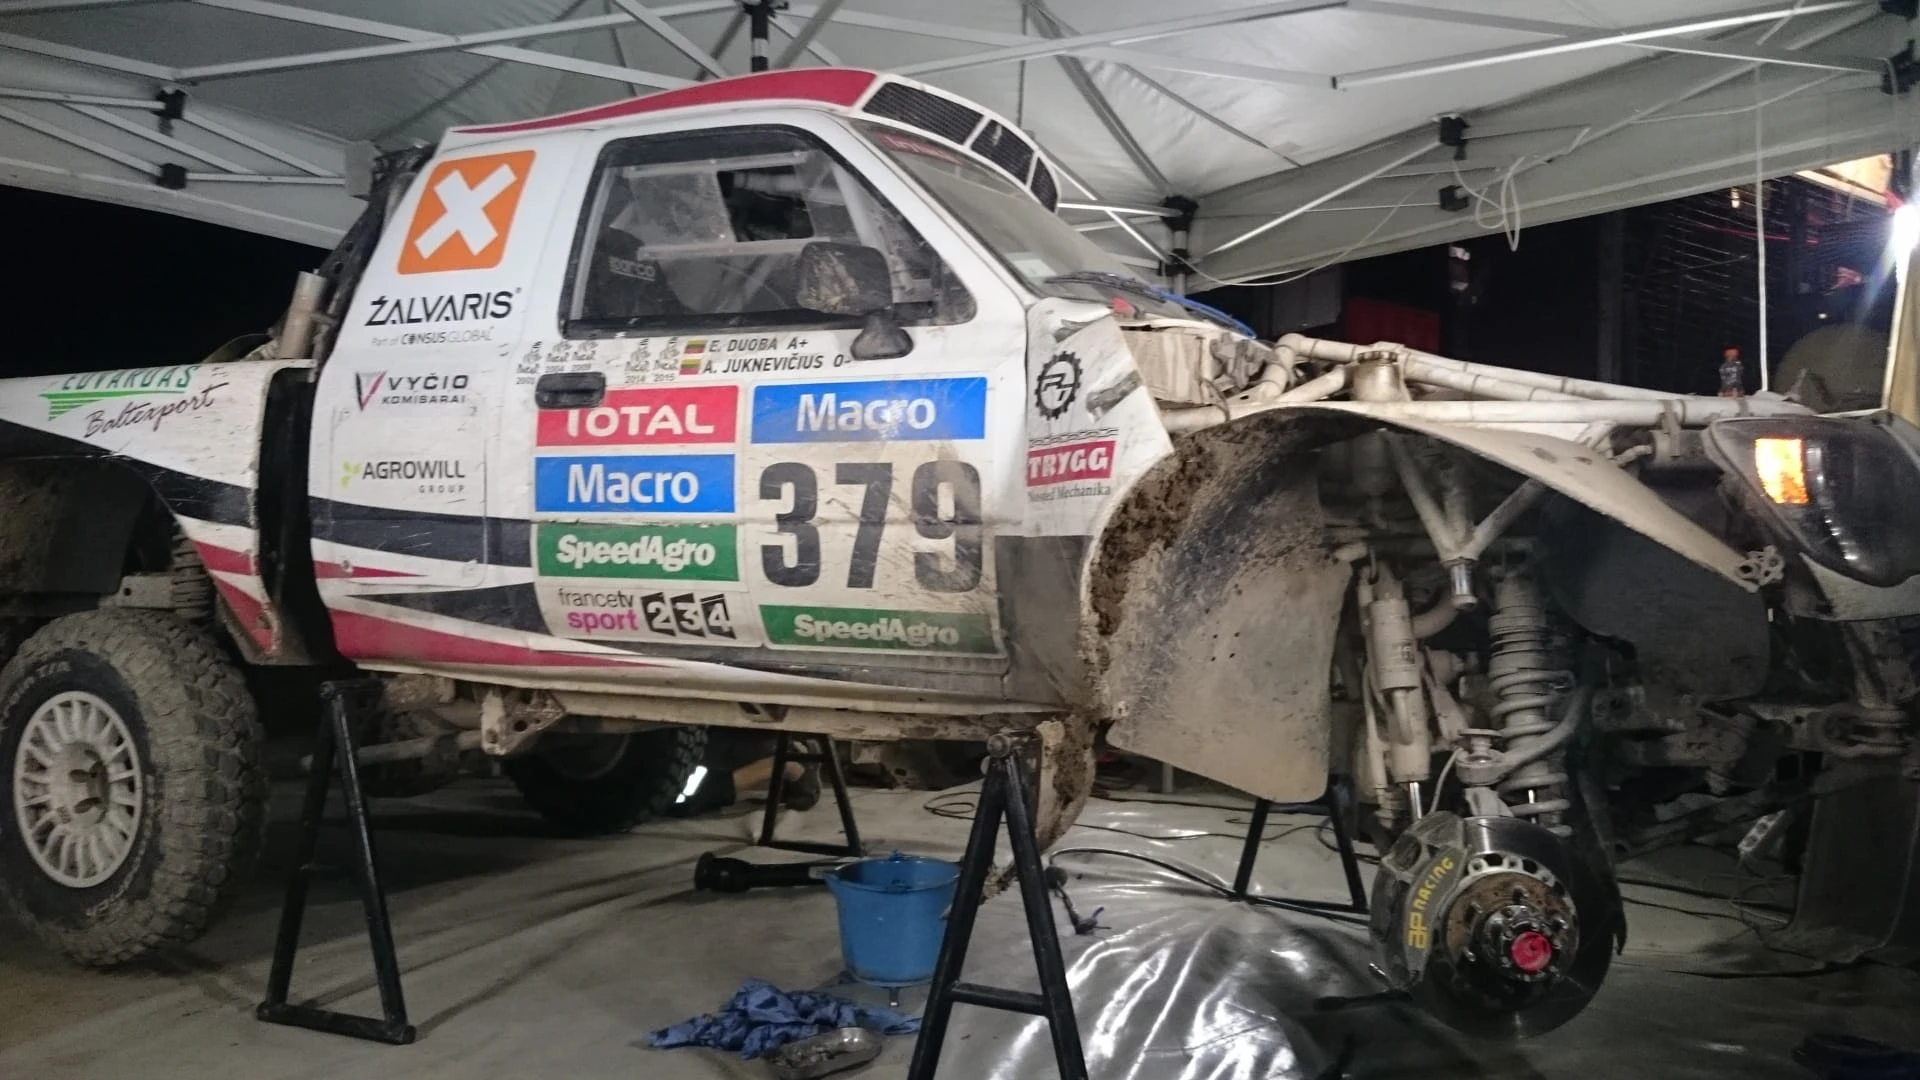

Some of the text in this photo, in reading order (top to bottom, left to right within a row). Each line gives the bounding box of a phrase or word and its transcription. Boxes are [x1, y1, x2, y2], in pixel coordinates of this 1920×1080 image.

[709, 337, 808, 353] E. DUOBA A+
[702, 362, 717, 374] A.
[722, 352, 823, 374] JUKNEVIČIUS
[388, 373, 469, 390] VYČIO
[797, 393, 936, 431] Macro
[362, 460, 466, 479] AGROWILL
[1028, 447, 1109, 479] TRYGG
[419, 485, 465, 493] GROUP
[568, 464, 699, 503] Macro
[759, 461, 982, 593] 379
[556, 534, 716, 572] SpeedAgro
[558, 588, 634, 608] francetv
[567, 609, 639, 632] sport
[794, 614, 959, 647] SpeedAgro
